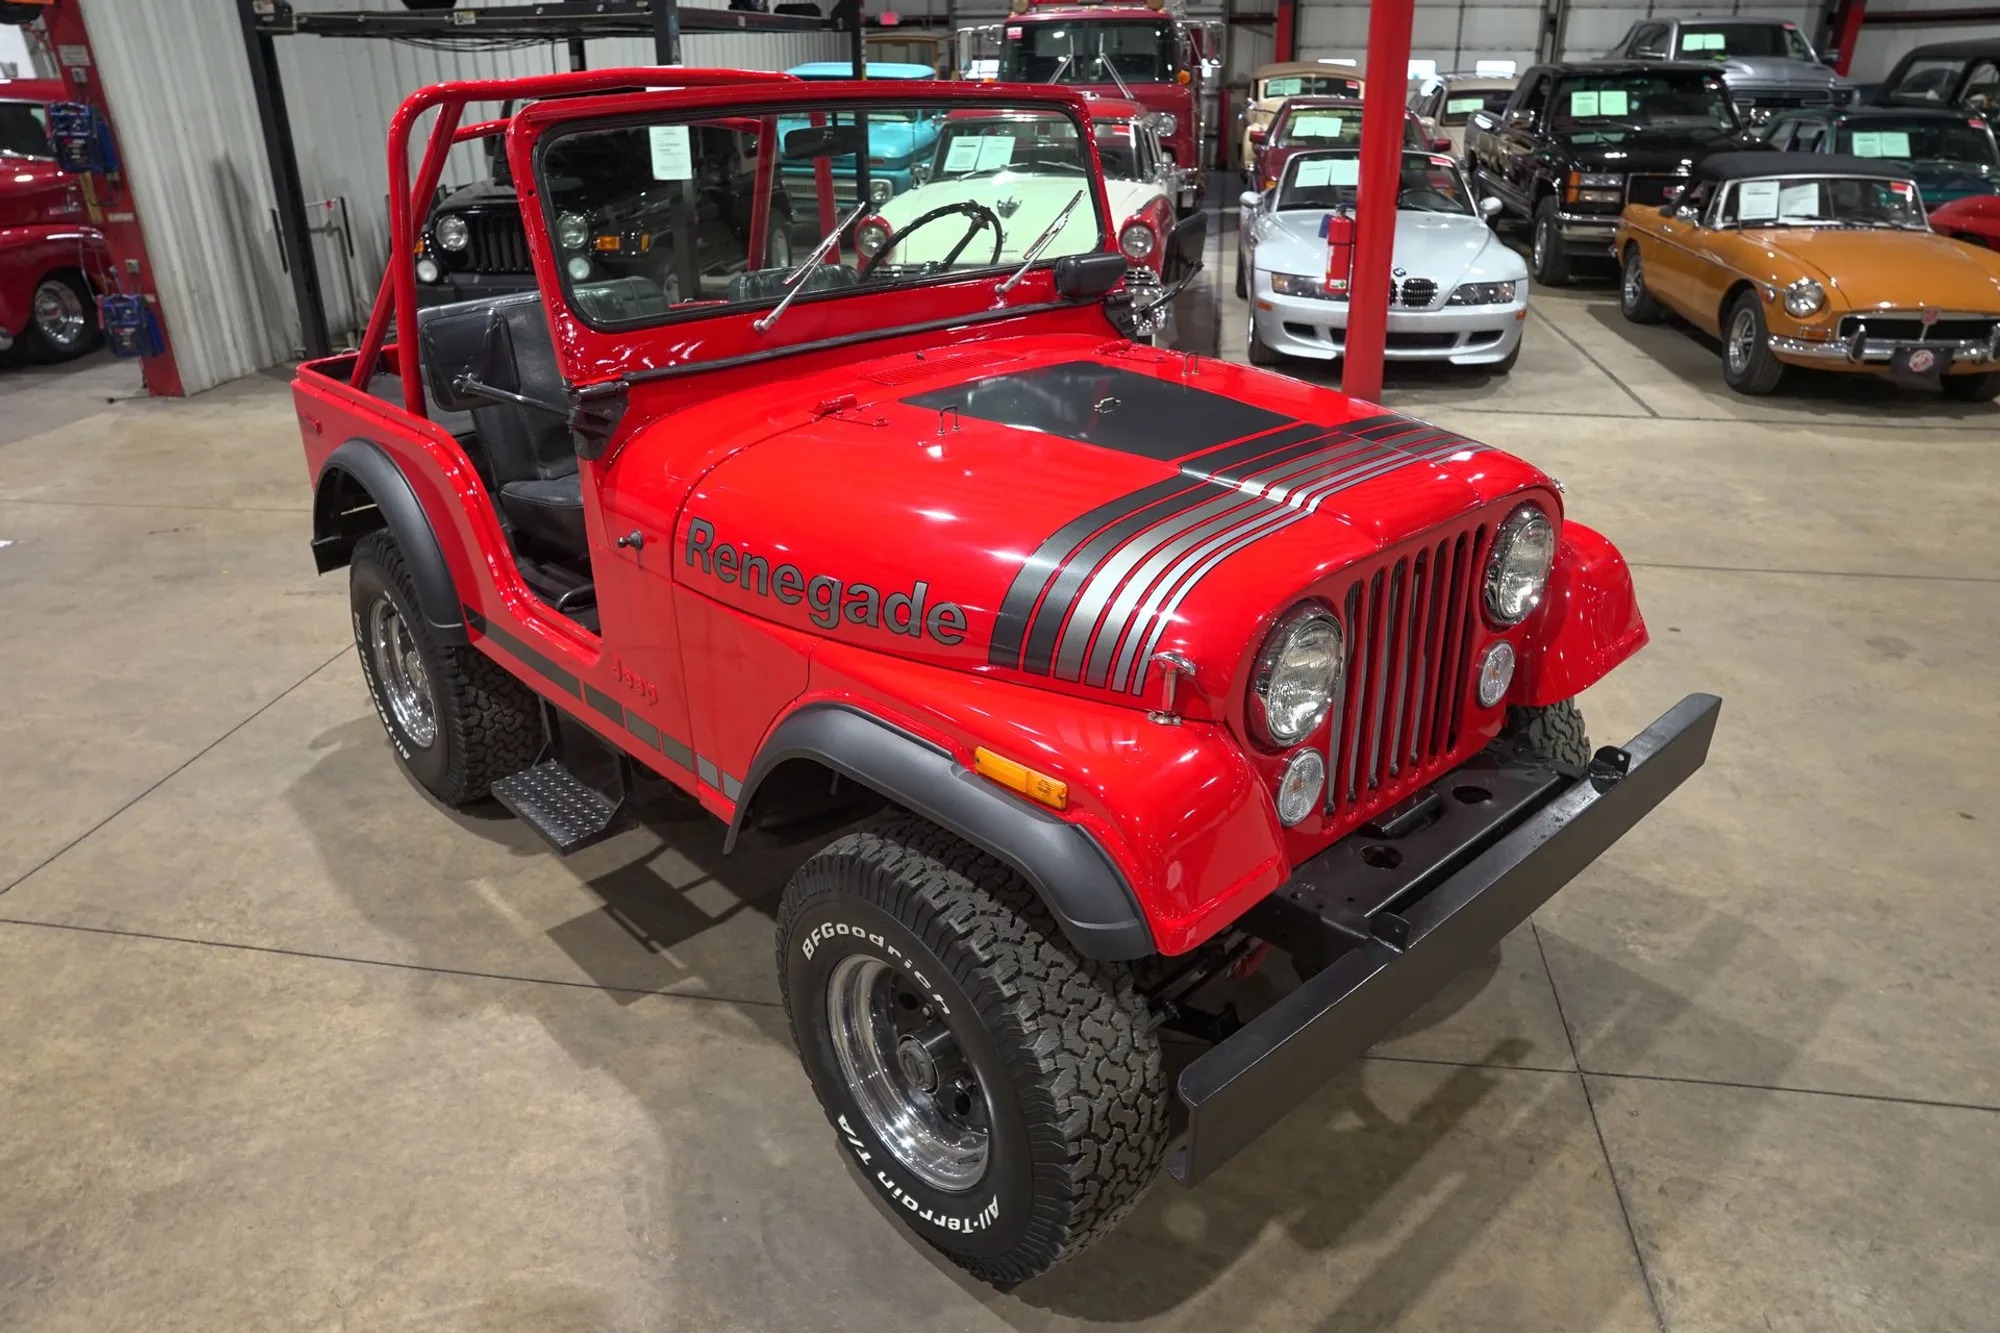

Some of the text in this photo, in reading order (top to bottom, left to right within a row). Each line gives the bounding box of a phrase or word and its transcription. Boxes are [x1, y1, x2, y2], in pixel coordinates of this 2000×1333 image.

[685, 516, 967, 645] Renegade
[610, 653, 659, 706] Jeep
[802, 922, 950, 1014] BFGoodrich
[838, 1114, 999, 1234] All-Terrain T/A
